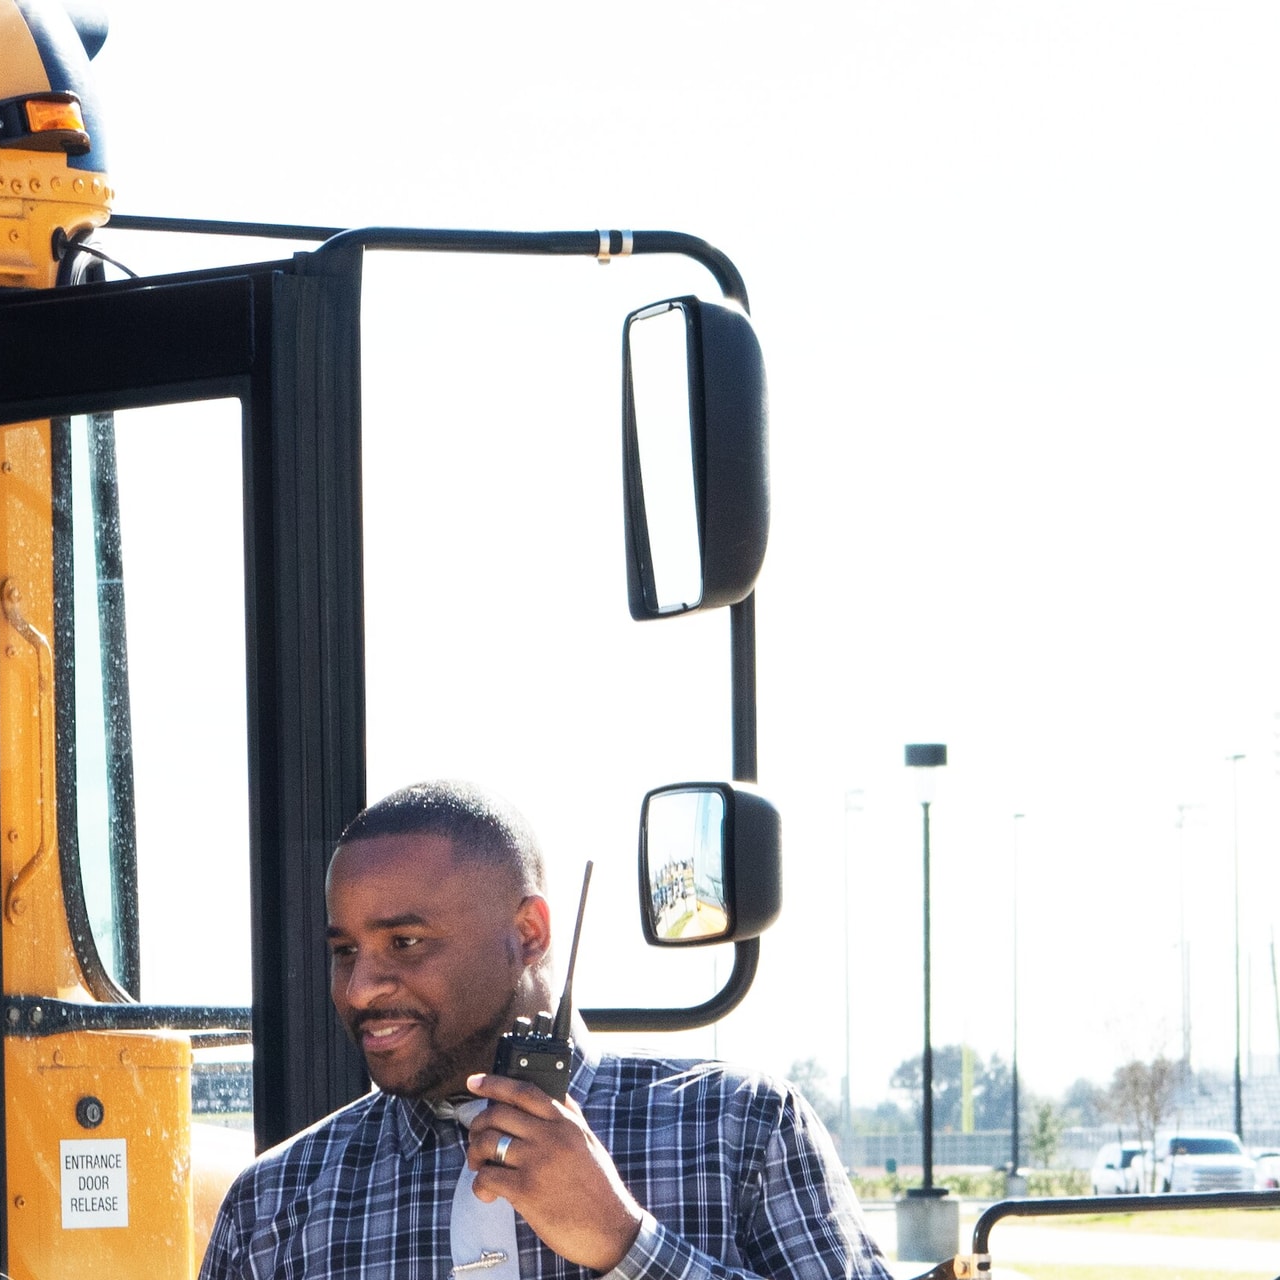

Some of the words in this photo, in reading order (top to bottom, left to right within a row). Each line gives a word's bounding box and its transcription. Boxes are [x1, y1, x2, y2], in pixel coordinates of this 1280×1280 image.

[65, 1155, 122, 1172] ENTRANCE
[78, 1176, 110, 1192] DOOR
[70, 1196, 118, 1212] RELEASE
